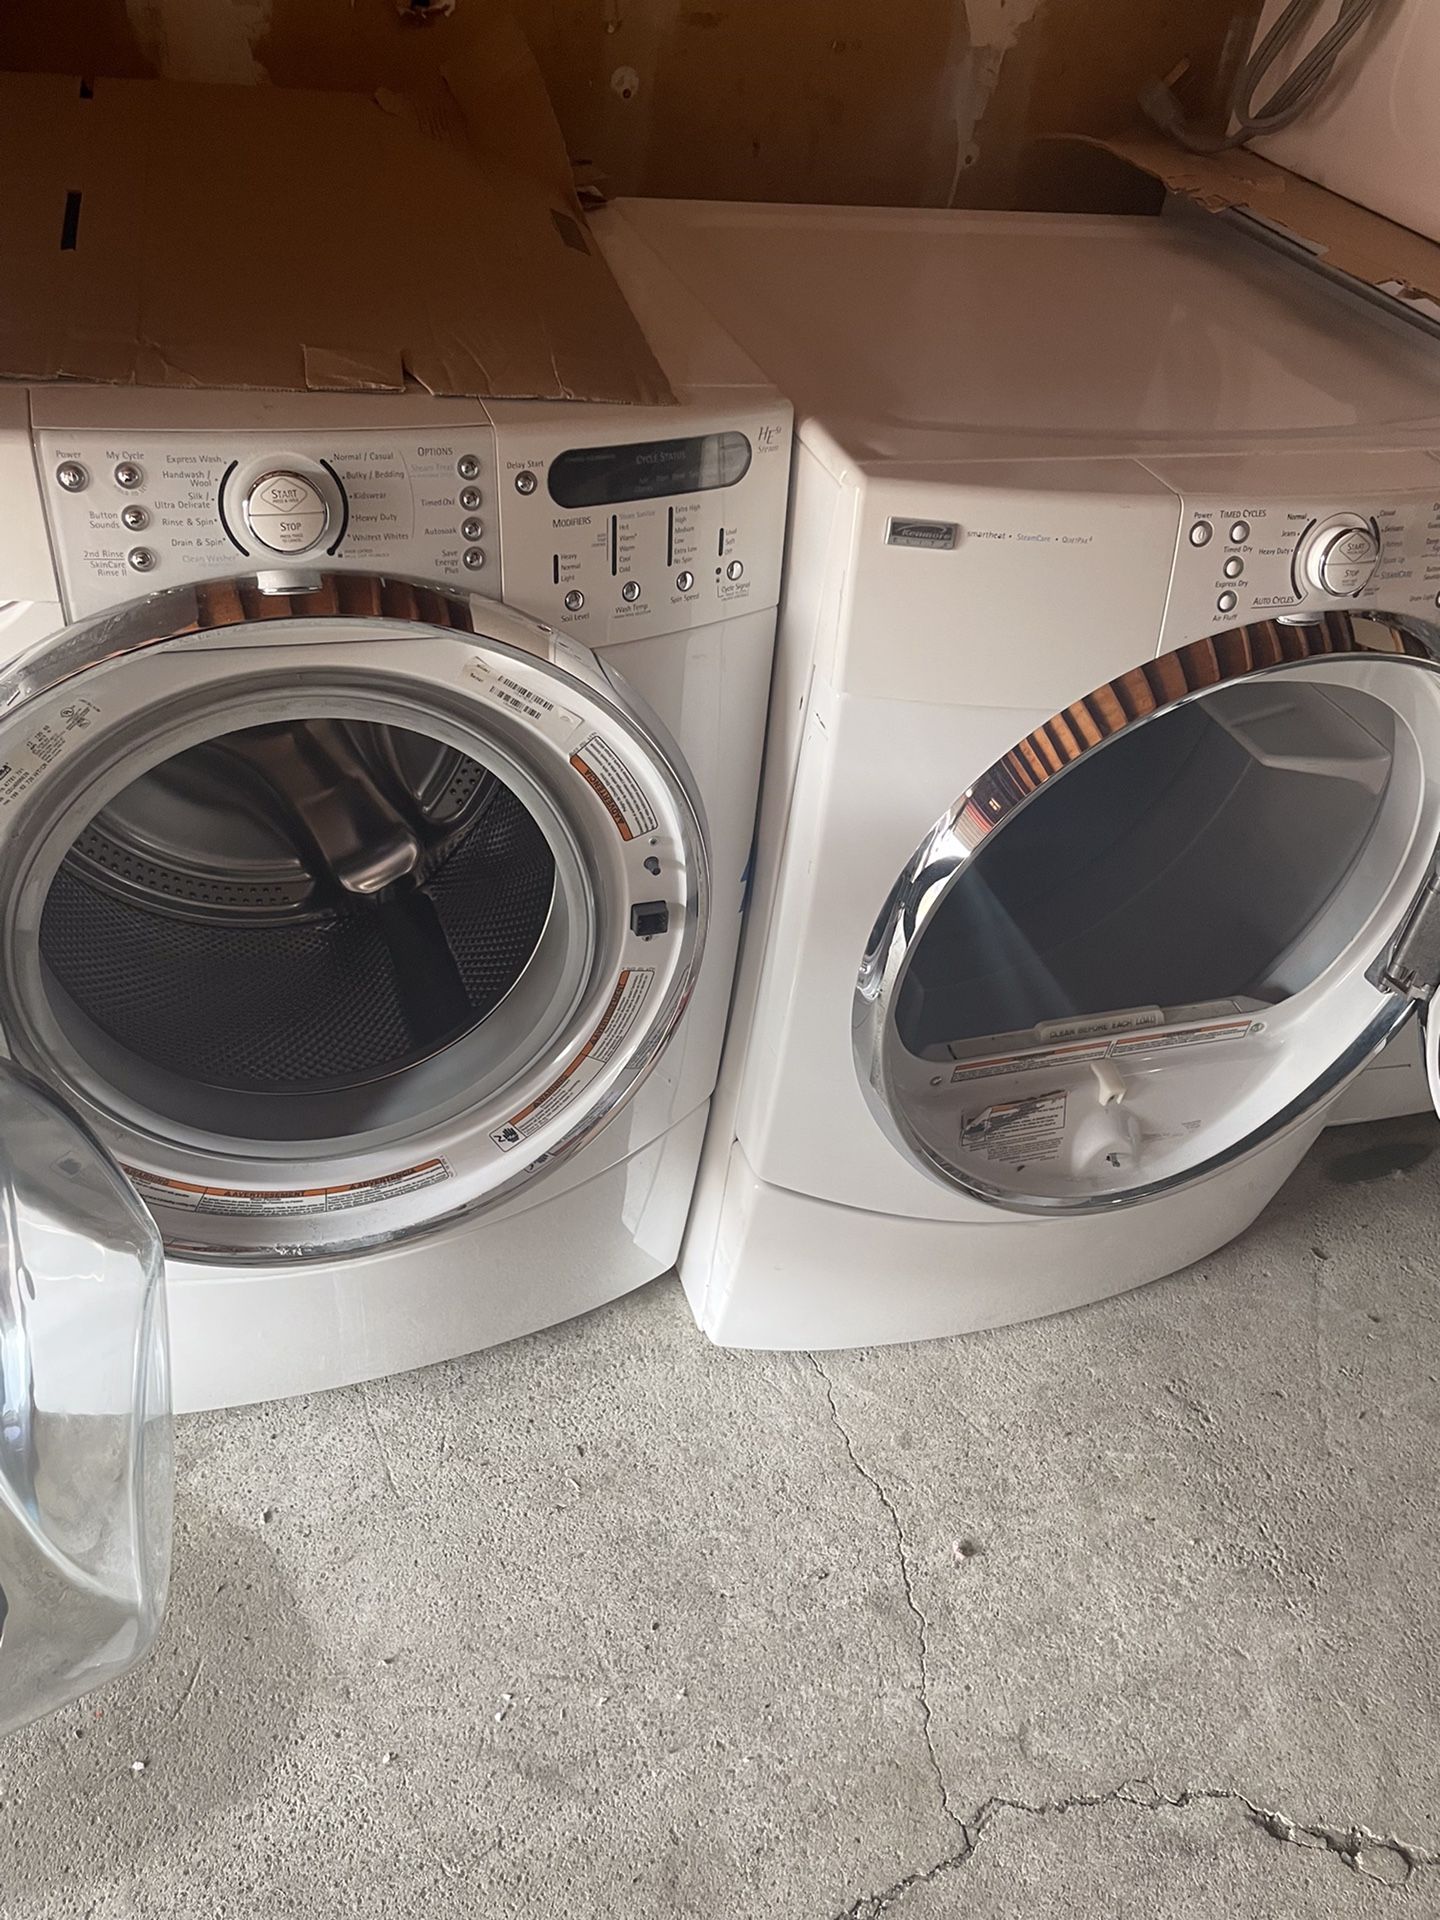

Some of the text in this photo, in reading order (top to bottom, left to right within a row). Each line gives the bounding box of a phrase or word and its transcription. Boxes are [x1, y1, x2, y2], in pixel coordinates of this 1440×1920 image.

[56, 450, 81, 458] Power
[106, 451, 145, 460] My Cycle
[334, 453, 361, 461] Normal
[369, 452, 394, 460] Casual
[417, 447, 453, 457] OPTIONS
[166, 455, 222, 466] Express Wash
[507, 460, 544, 469] Delay Start
[162, 470, 205, 479] Handwash
[346, 471, 367, 480] Bulky
[375, 471, 405, 479] Bedding
[190, 479, 212, 487] Wool
[188, 492, 203, 500] Silk
[271, 489, 298, 499] START
[155, 501, 211, 509] Ultra Delicate
[89, 511, 118, 519] Button
[355, 513, 397, 523] Heavy Duty
[1220, 509, 1267, 519] TIMED CYCLES
[89, 521, 120, 529] Sounds
[162, 518, 214, 528] Rinse & Spin
[552, 516, 592, 528] MODIFIERS
[280, 523, 302, 532] STOP
[352, 533, 409, 542] Whitest Whites
[902, 528, 951, 540] Kenmore
[967, 531, 1006, 540] smartheat
[171, 538, 223, 549] Drain & Spin
[1243, 545, 1253, 553] Dry
[84, 550, 124, 558] 2nd Rinse
[90, 561, 126, 569] SkinCare
[97, 568, 119, 577] Rinse
[1238, 580, 1248, 588] Dry
[1253, 595, 1295, 605] AUTO CYCLES
[615, 606, 632, 614] Wash
[561, 613, 590, 623] Soil Level
[583, 769, 624, 818] ADVERTENCIA
[230, 1190, 304, 1199] AVERTISSEMENT
